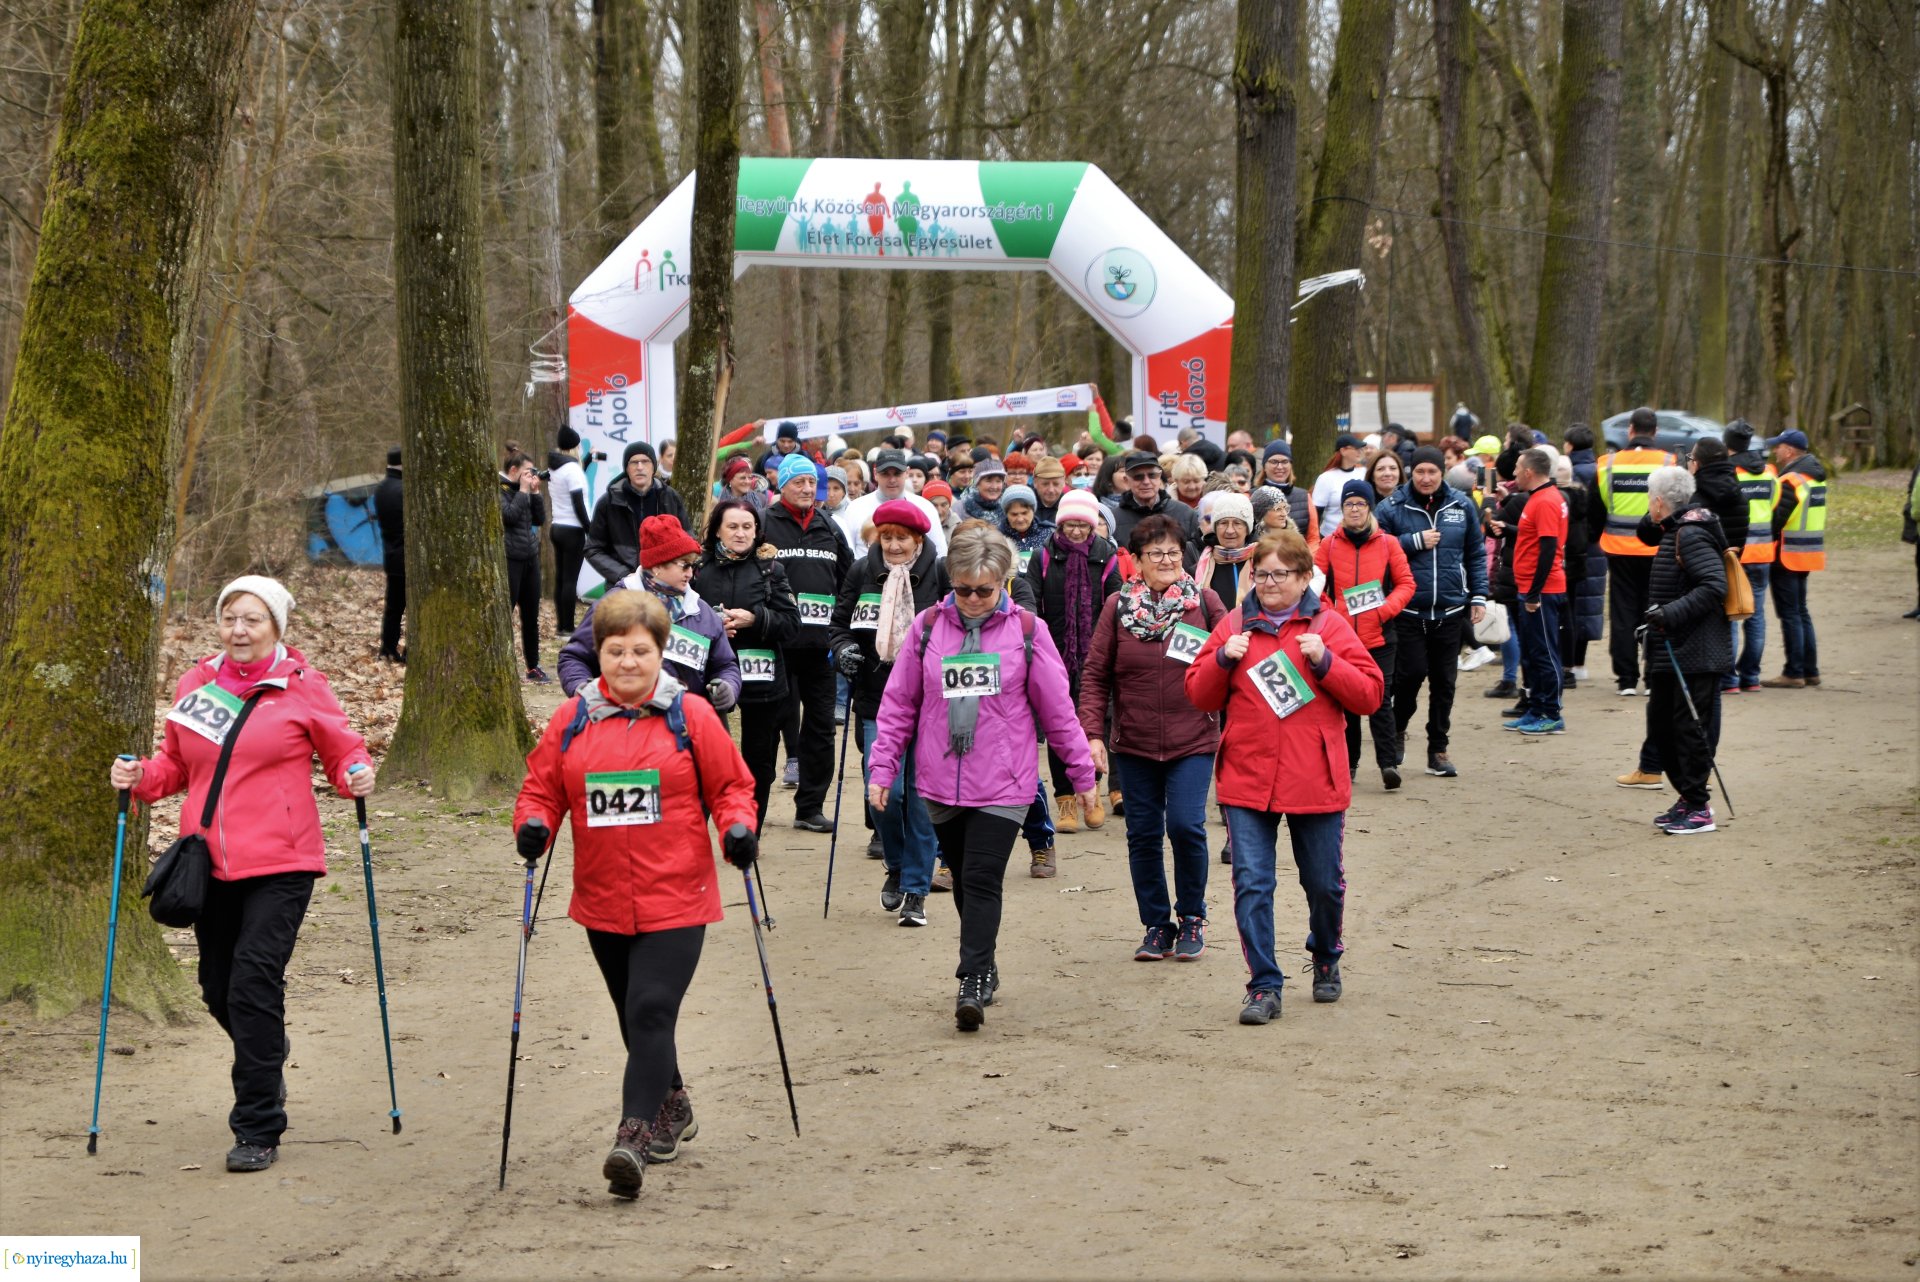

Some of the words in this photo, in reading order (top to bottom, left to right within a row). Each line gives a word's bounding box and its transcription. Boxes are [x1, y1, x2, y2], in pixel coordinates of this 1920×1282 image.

[813, 198, 886, 215] Közösen
[892, 201, 1042, 222] Magyarországért
[806, 227, 840, 246] Élet
[908, 234, 993, 250] Egyesület
[586, 389, 603, 426] Fitt
[603, 374, 632, 443] Ápoló
[1159, 391, 1178, 428] Fitt
[800, 603, 829, 618] 039
[1349, 590, 1378, 608] 073
[853, 604, 880, 621] 065
[665, 635, 700, 660] 064
[742, 658, 771, 674] 012
[944, 666, 990, 688] 063
[1258, 660, 1297, 704] 023
[179, 694, 231, 729] 029
[590, 787, 647, 815] 042
